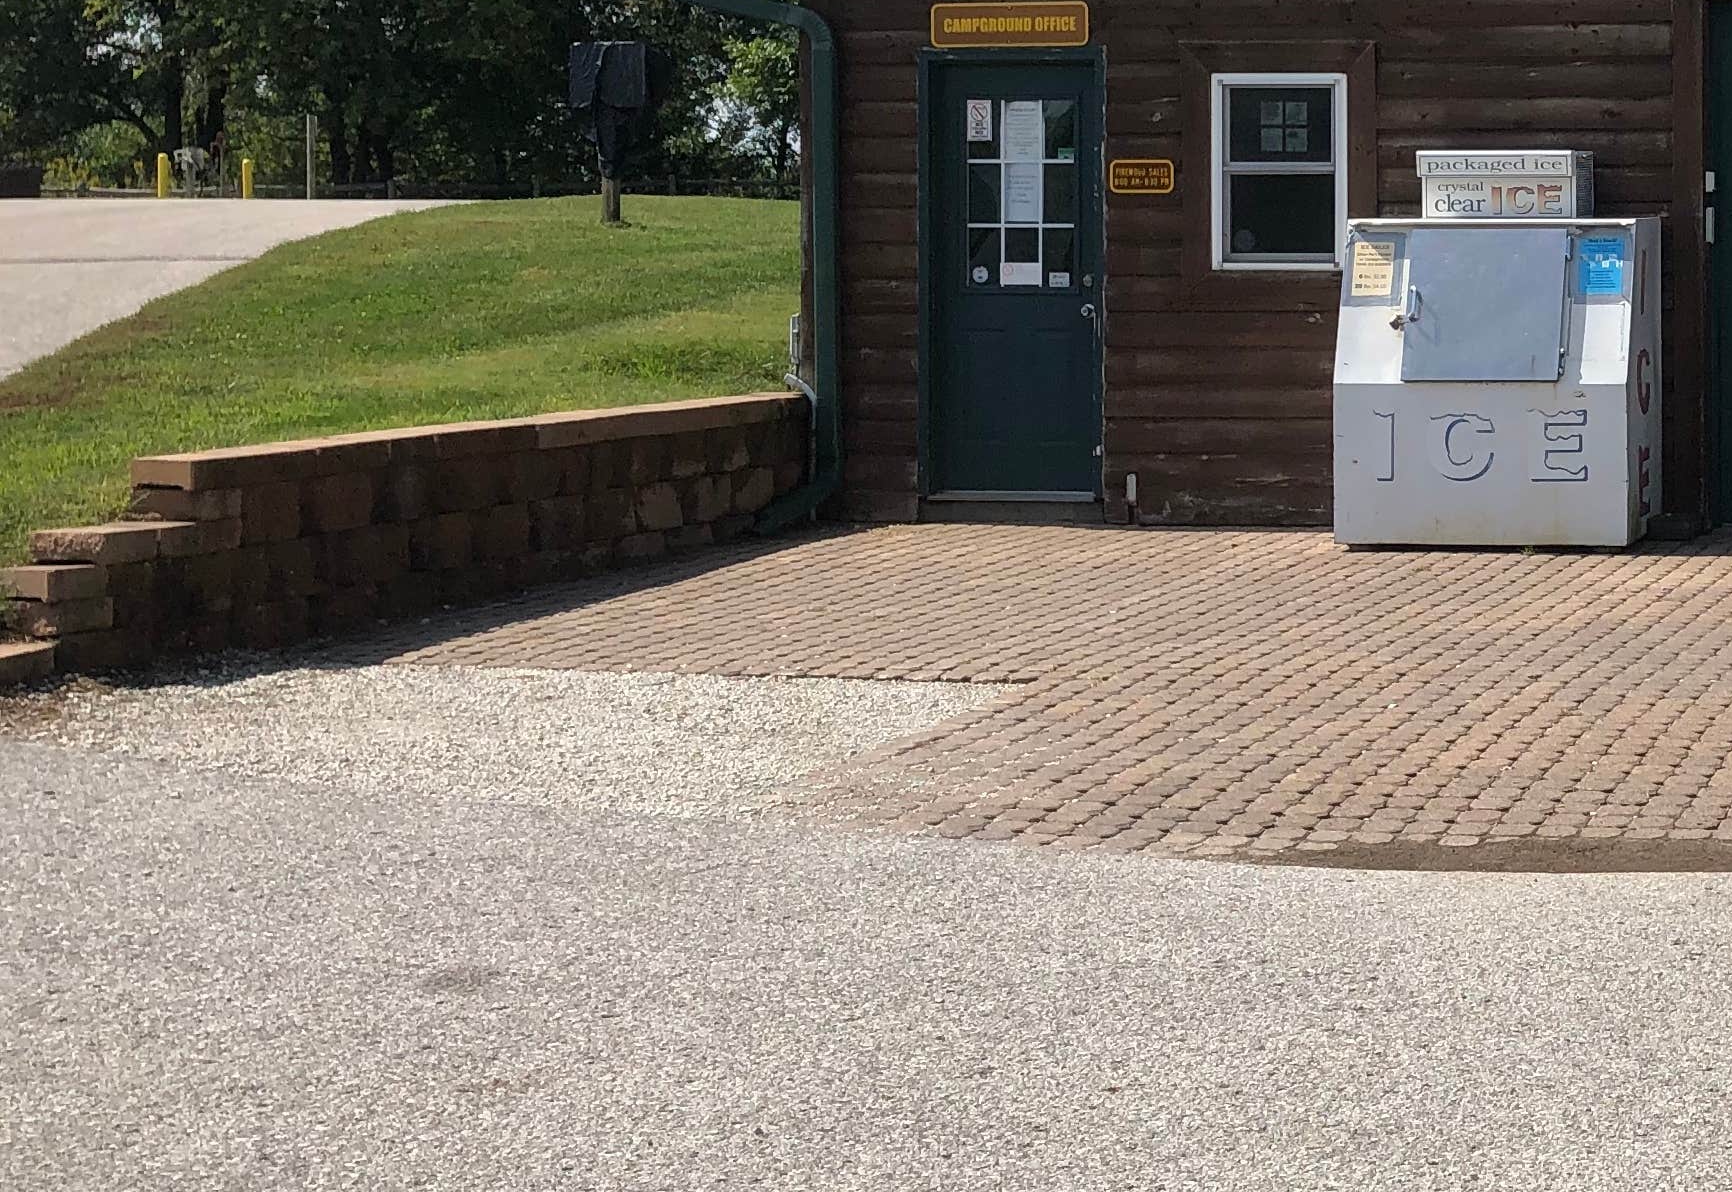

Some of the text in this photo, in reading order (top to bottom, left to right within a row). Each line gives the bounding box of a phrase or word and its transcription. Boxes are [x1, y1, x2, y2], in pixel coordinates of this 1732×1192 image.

[943, 15, 1077, 34] CAMPGROUND OFFICE
[1427, 157, 1563, 174] packaged ice
[1434, 194, 1487, 214] clear
[1437, 181, 1563, 216] crystal ICE
[1372, 408, 1589, 483] ICE
